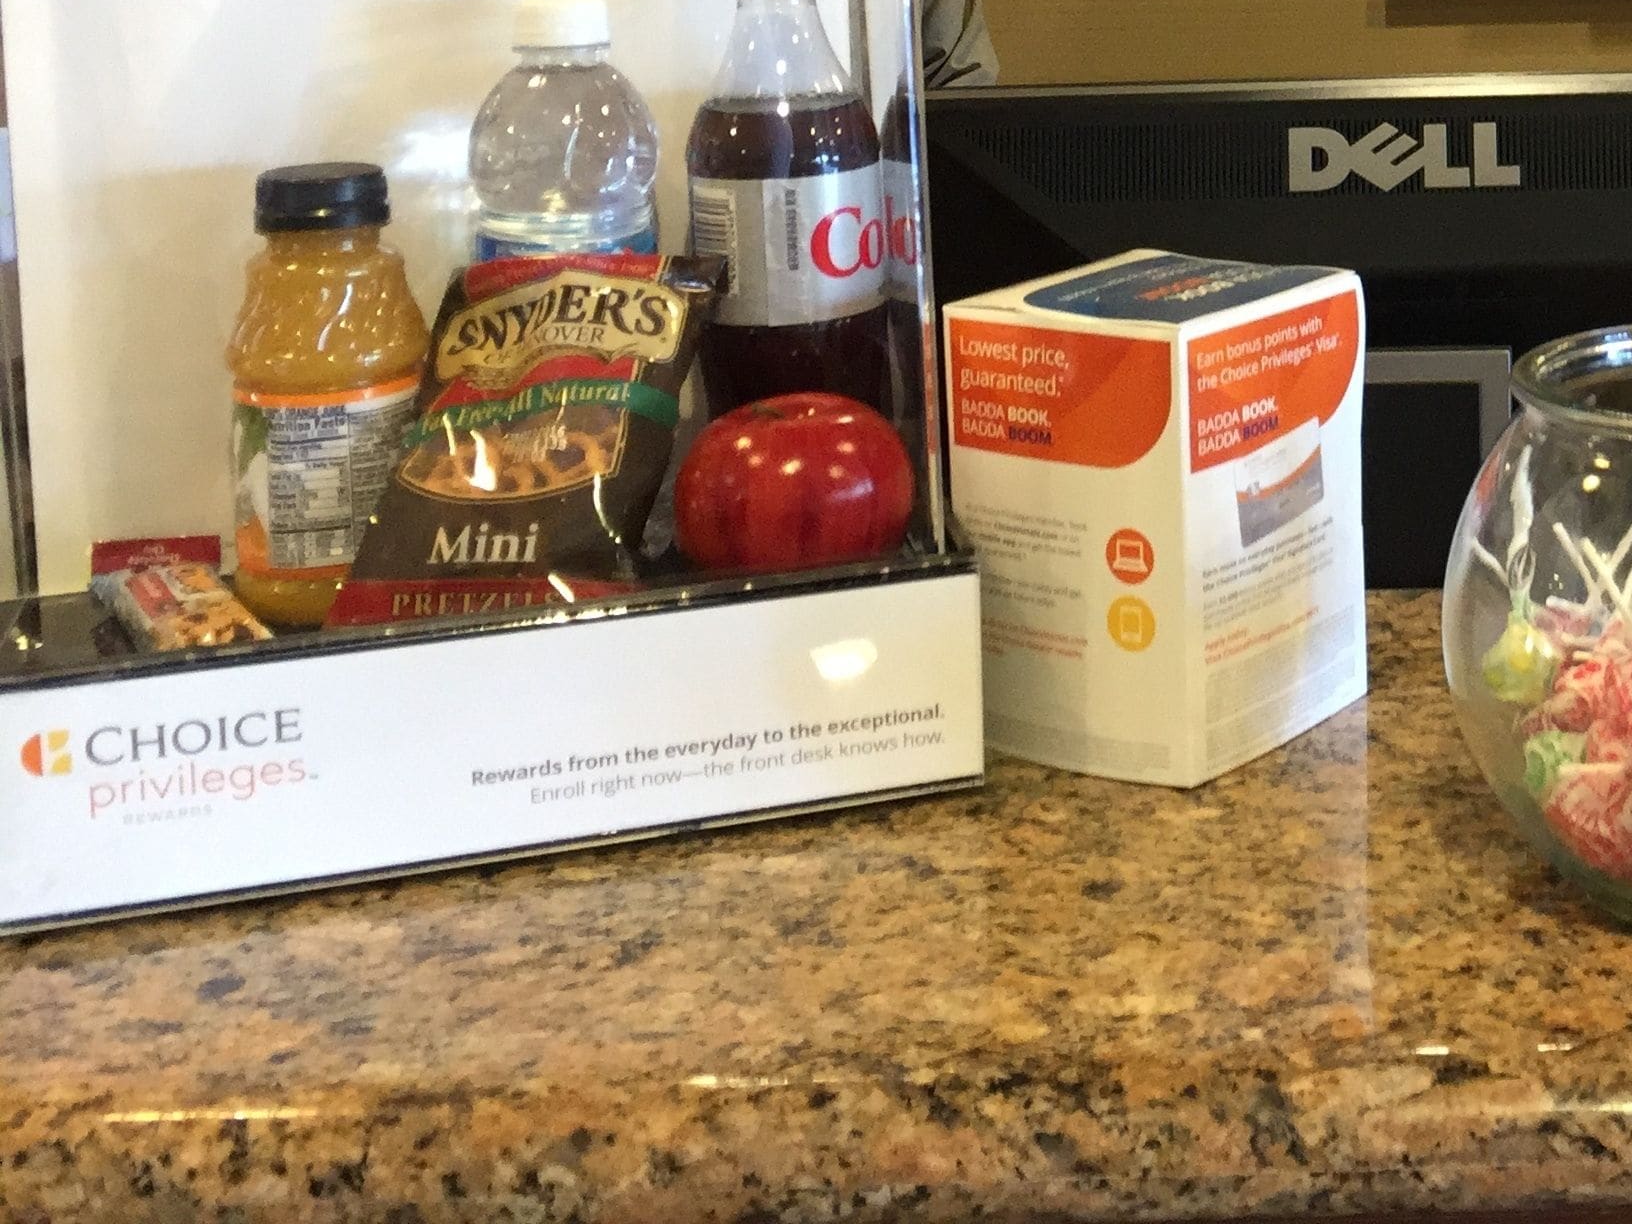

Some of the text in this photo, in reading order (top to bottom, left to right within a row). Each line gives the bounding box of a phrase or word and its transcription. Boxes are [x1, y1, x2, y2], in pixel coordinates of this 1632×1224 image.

[1288, 121, 1520, 192] DELL
[446, 283, 670, 357] SNYDER'S
[1196, 314, 1323, 371] Earn bonus points with
[959, 335, 1070, 370] Lowest price,
[1197, 375, 1218, 394] the
[1219, 363, 1260, 385] Choice
[961, 398, 1005, 422] BADDA
[962, 418, 1008, 442] BADDA
[1197, 409, 1241, 437] BADDA
[1197, 429, 1242, 457] BADDA
[426, 522, 539, 564] Mini
[85, 707, 304, 767] CHOICE
[471, 702, 945, 787] Rewards from the everyday to the exceptional.
[89, 755, 307, 820] privileges
[530, 779, 585, 805] Enroll
[590, 772, 636, 799] right
[740, 750, 785, 774] front
[791, 743, 834, 766] desk
[839, 734, 899, 758] knows
[903, 727, 946, 750] how.
